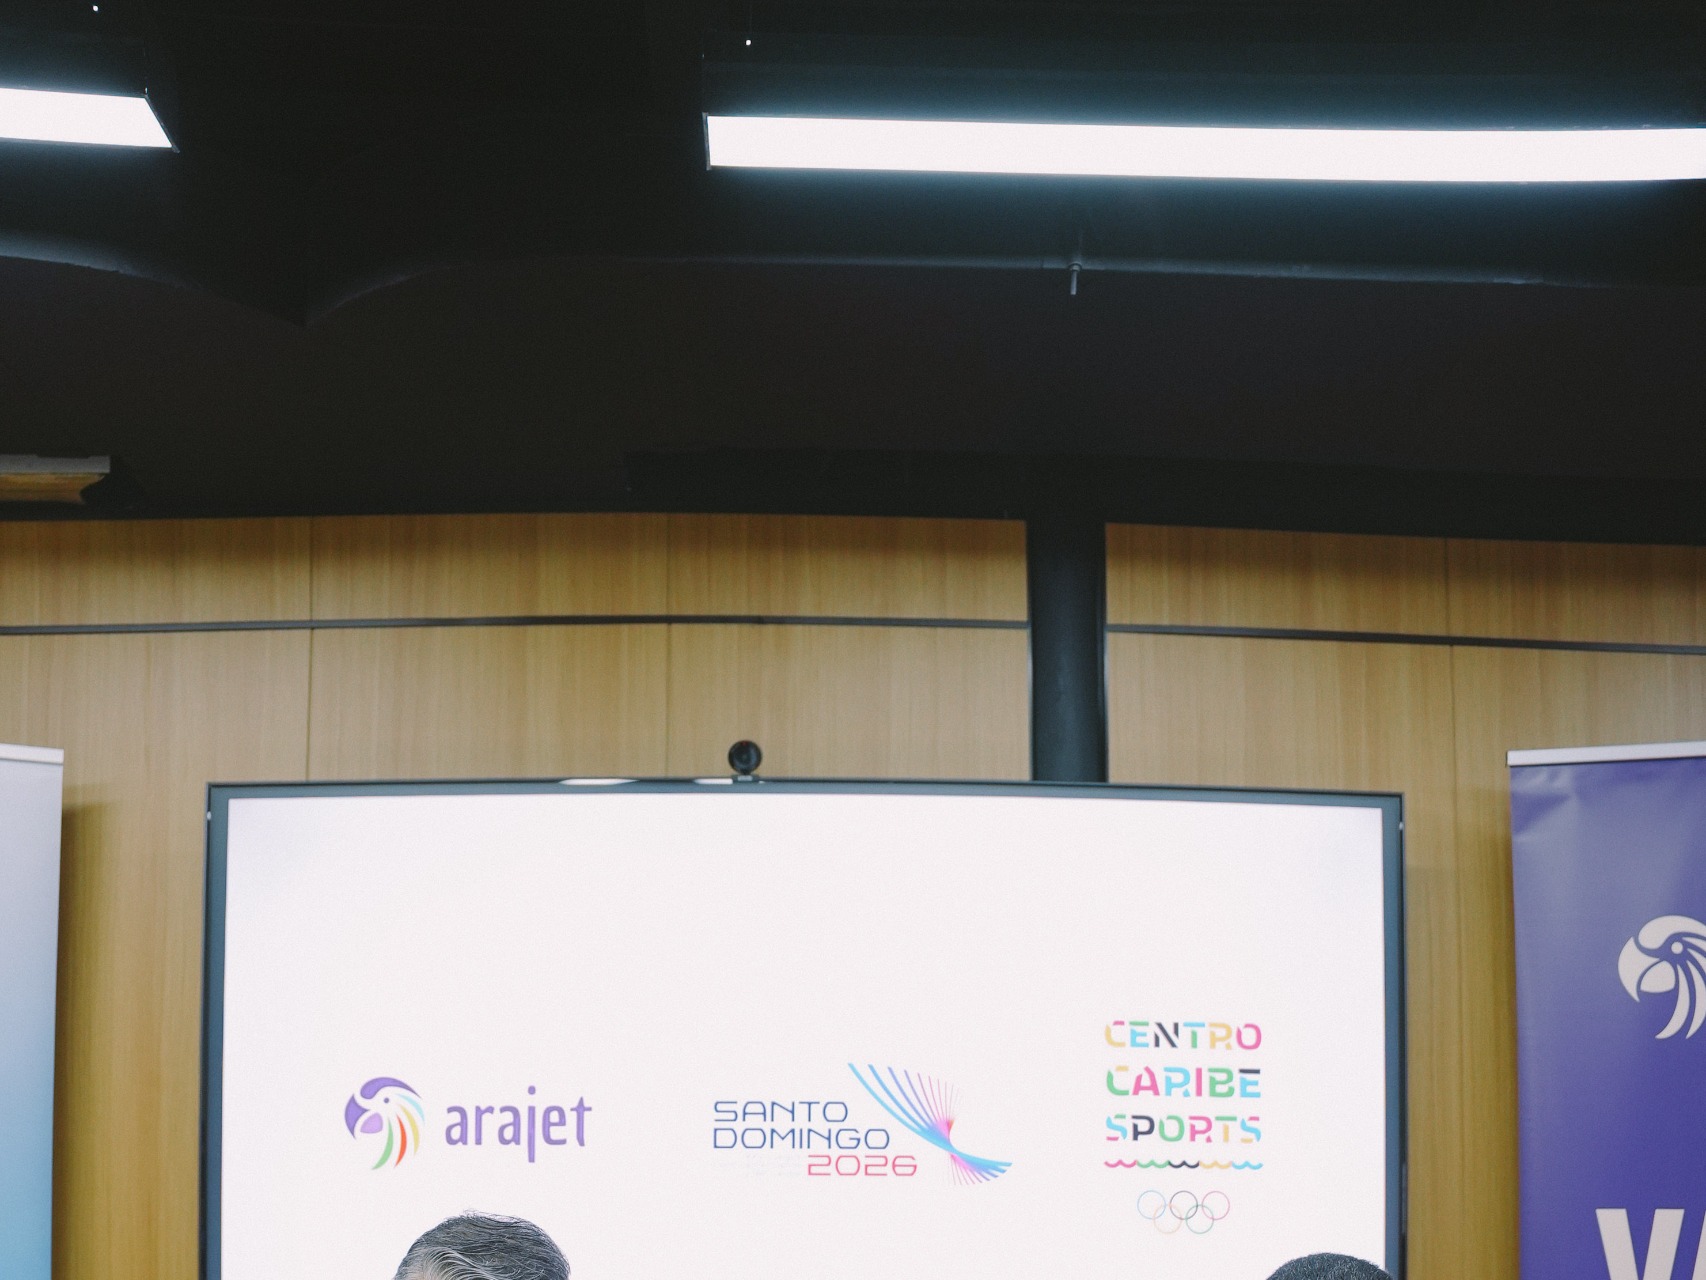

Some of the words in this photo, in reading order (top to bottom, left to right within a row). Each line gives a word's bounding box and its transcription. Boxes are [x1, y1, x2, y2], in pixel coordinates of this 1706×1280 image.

[1104, 1020, 1263, 1050] CENTRO
[1105, 1065, 1262, 1098] CARIBE
[445, 1085, 593, 1163] arajet
[713, 1101, 848, 1123] SANTO
[712, 1128, 890, 1150] DOMINGO
[1105, 1114, 1262, 1143] SPORTS
[807, 1154, 918, 1177] 2026
